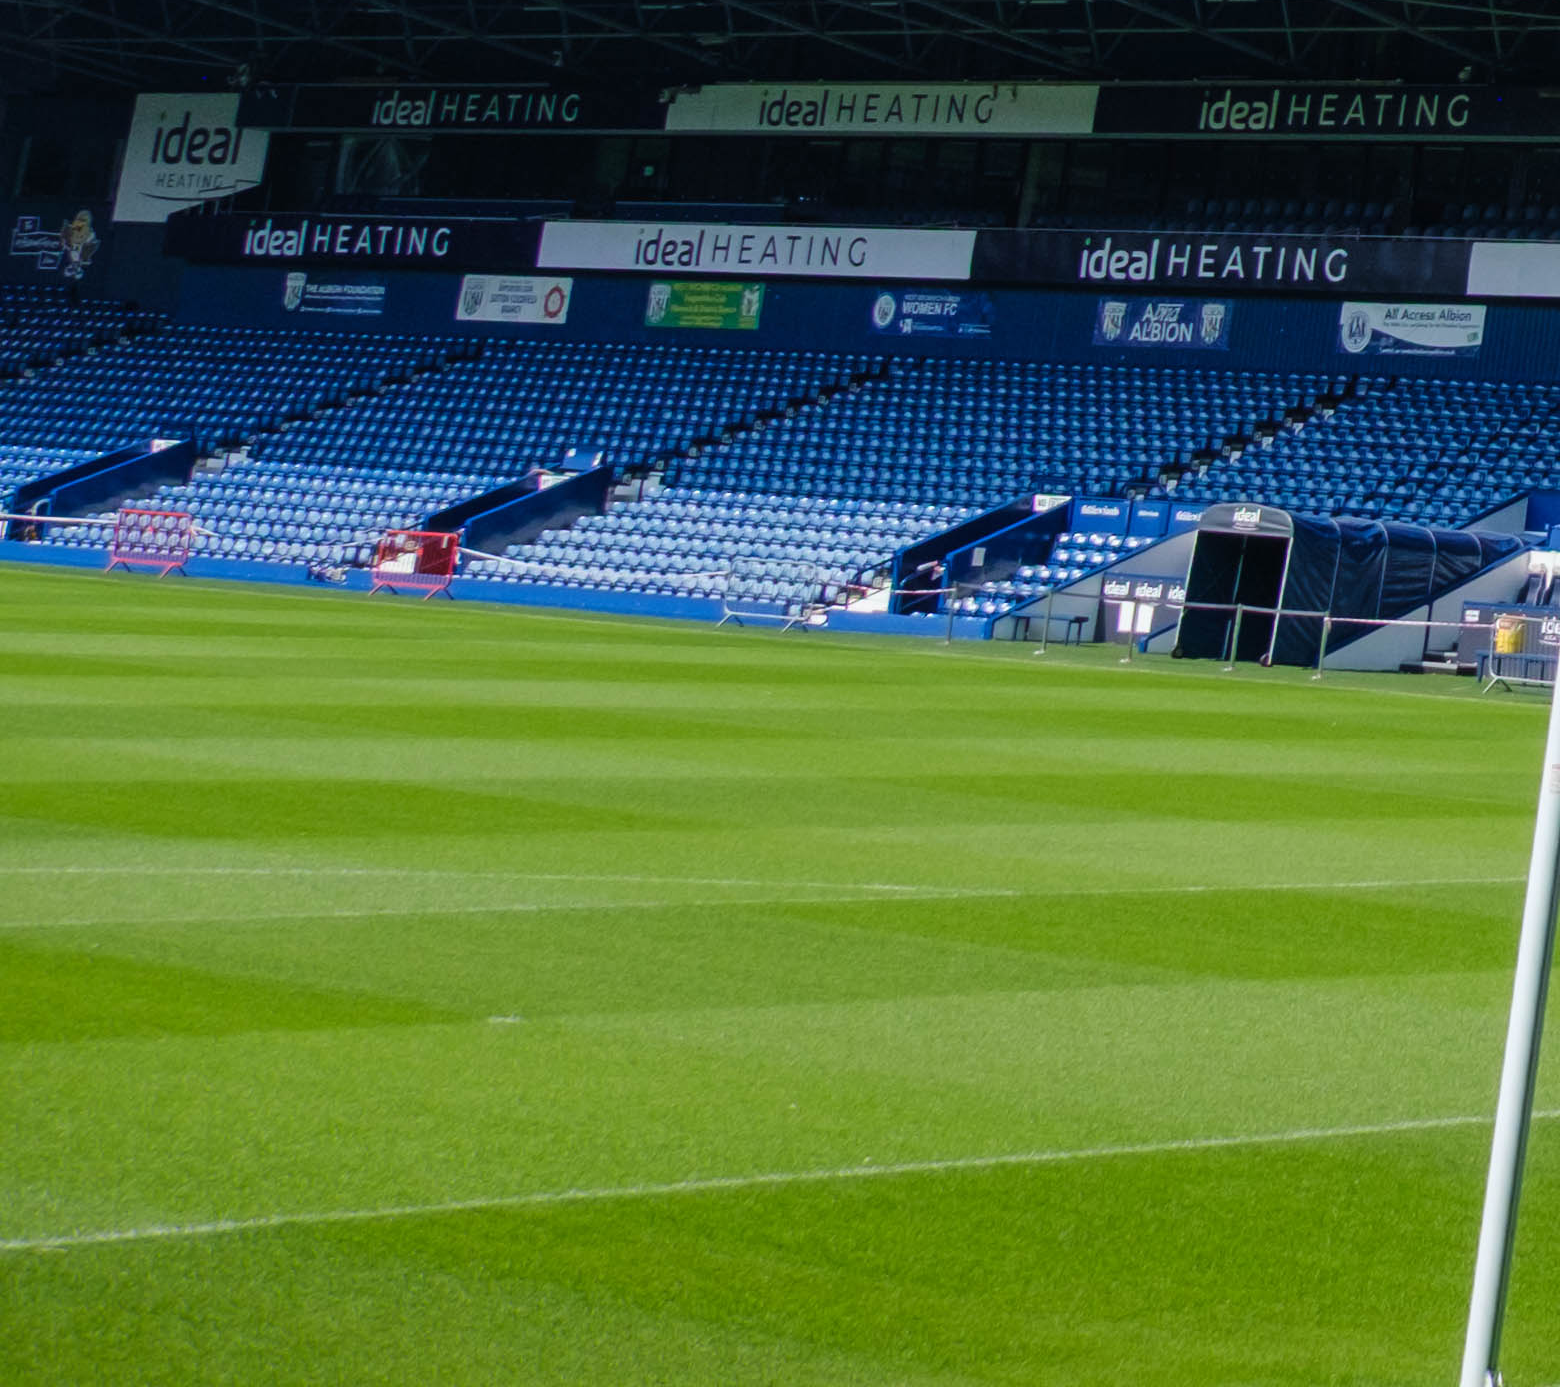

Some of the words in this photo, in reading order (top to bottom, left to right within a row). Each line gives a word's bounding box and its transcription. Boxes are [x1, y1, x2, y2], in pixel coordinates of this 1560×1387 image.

[371, 91, 433, 126] ideal
[440, 93, 580, 122] HEATING
[758, 89, 826, 127] ideal
[836, 93, 994, 123] HEATING
[1200, 90, 1279, 130] ideal
[1288, 94, 1470, 126] HEATING
[150, 111, 244, 165] ideal
[156, 173, 223, 189] HEATING
[244, 219, 305, 256] ideal
[311, 225, 452, 256] HEATING
[634, 229, 706, 267] ideal
[711, 234, 868, 267] HEATING
[1079, 238, 1159, 281] ideal
[1167, 244, 1348, 282] HEATING
[903, 302, 941, 315] WOMEN
[943, 303, 958, 315] FC
[1401, 309, 1435, 321] Access
[1439, 310, 1472, 322] Albion
[1128, 321, 1193, 342] ALBION
[1233, 507, 1261, 523] ideal
[1104, 581, 1130, 595] ideal
[1136, 581, 1163, 598] ideal
[1168, 585, 1185, 600] ide
